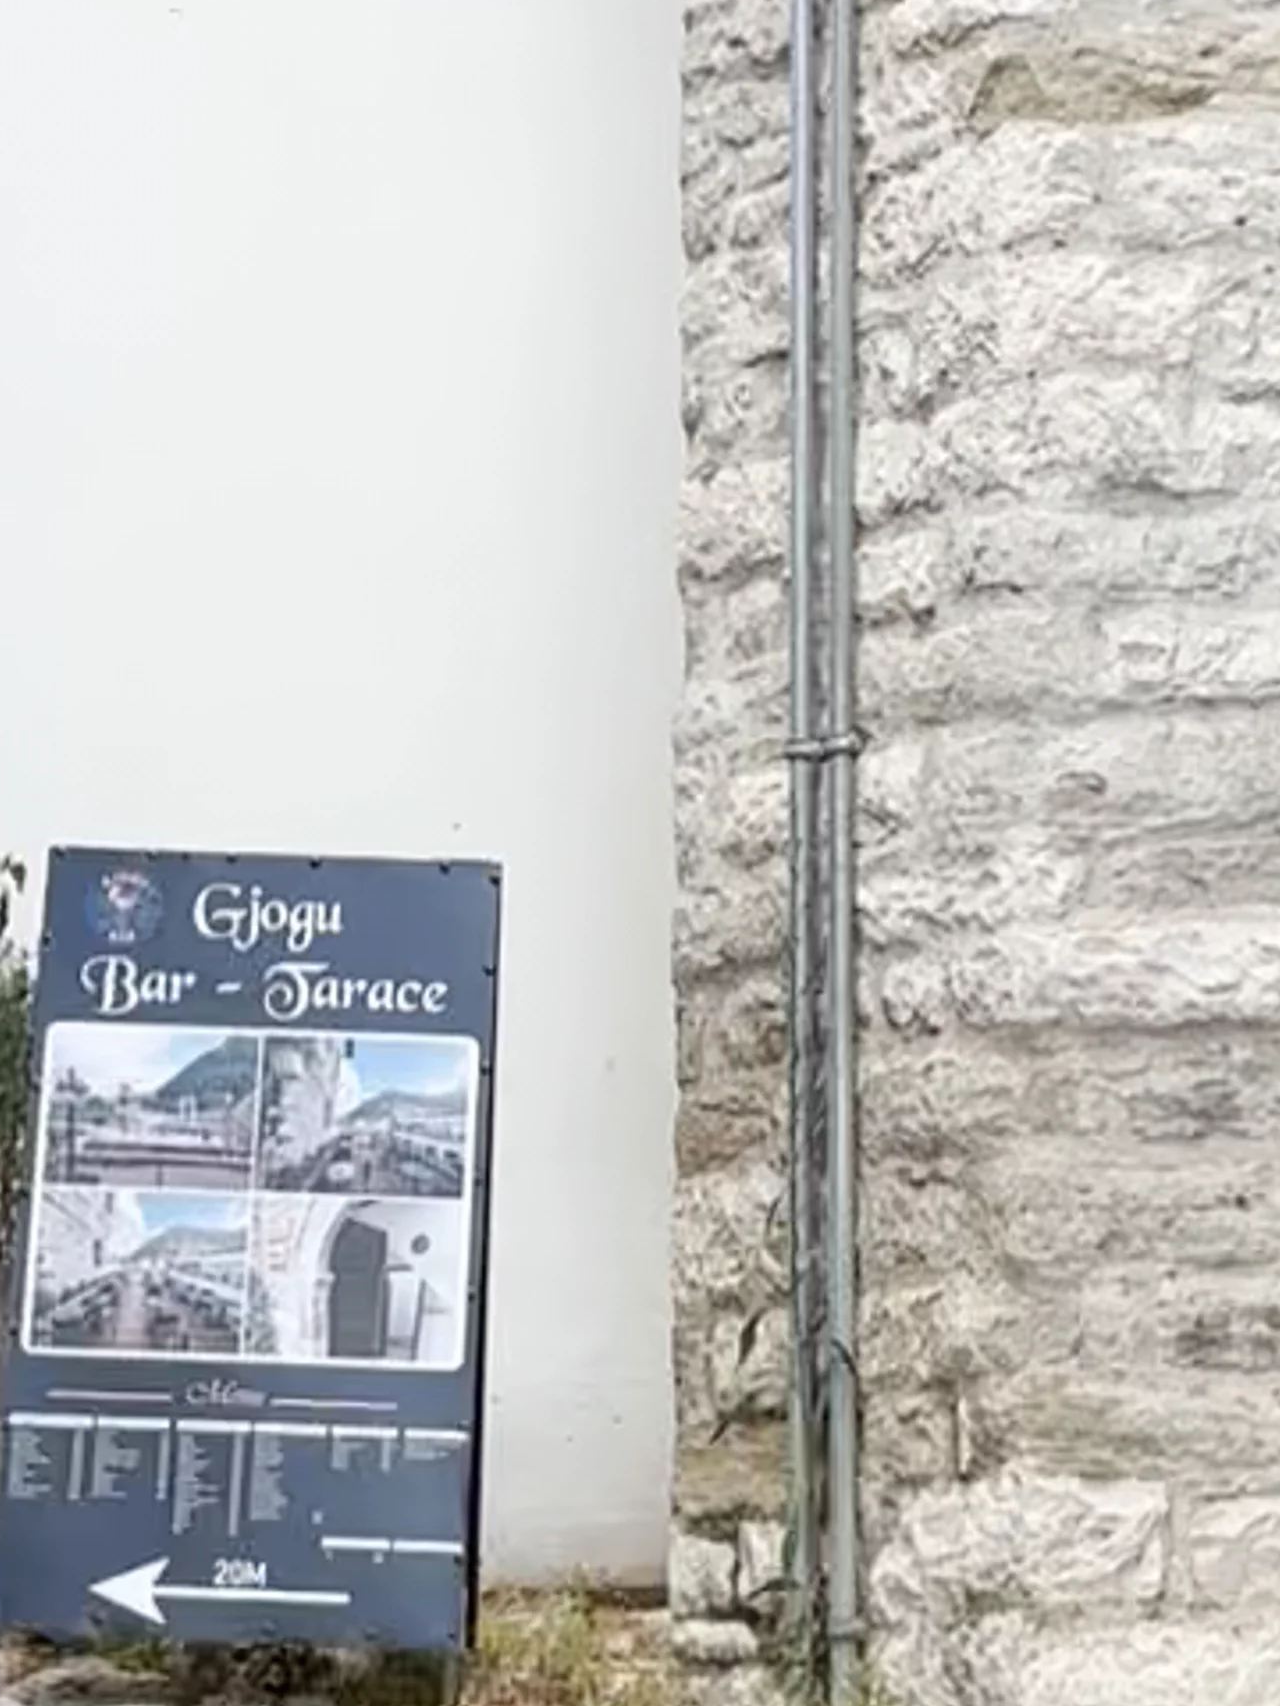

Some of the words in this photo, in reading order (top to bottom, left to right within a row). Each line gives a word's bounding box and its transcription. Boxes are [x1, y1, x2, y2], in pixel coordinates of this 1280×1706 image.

[193, 882, 344, 952] Gjogu
[79, 953, 196, 1015] Bar
[263, 960, 450, 1021] Tarace
